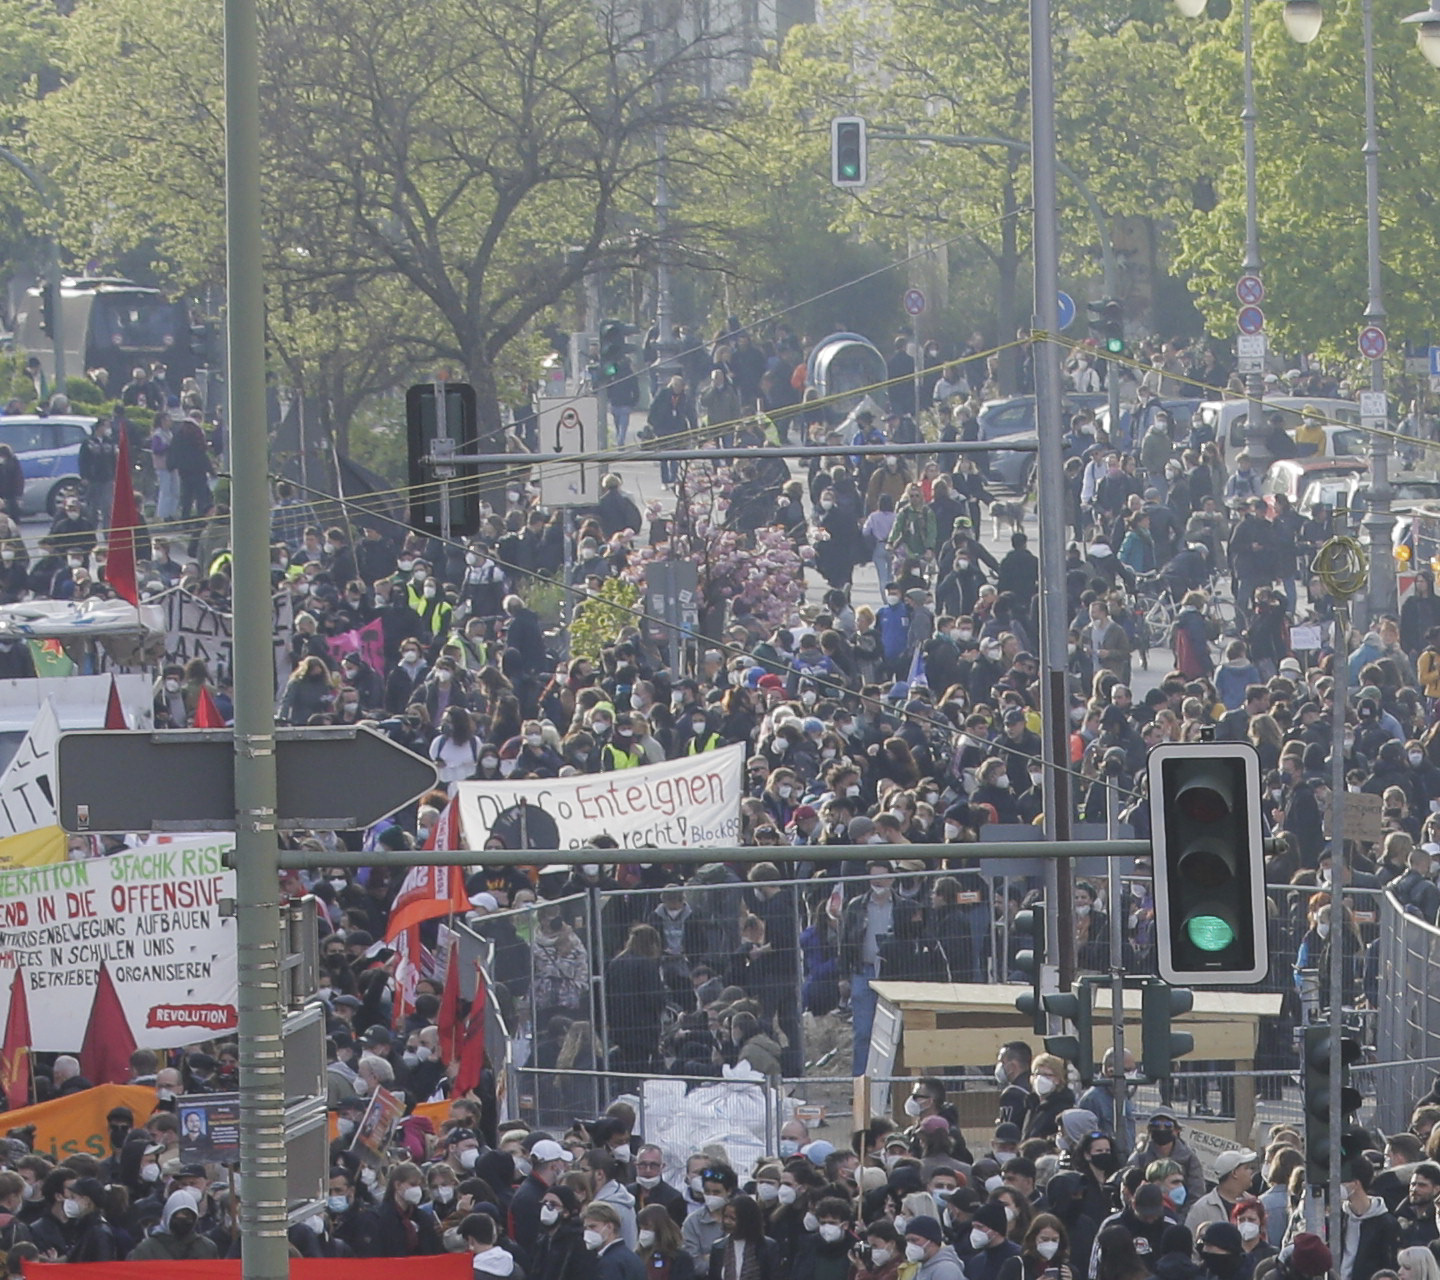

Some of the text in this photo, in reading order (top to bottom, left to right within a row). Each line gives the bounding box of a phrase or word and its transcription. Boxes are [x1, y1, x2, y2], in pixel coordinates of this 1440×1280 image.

[576, 771, 725, 820] Enteignen
[38, 896, 57, 924] IN
[67, 889, 97, 919] DIE
[111, 876, 224, 913] OFFENSIVE
[135, 910, 210, 936] AUFBAUEN
[69, 939, 135, 965] SCHULEN
[143, 938, 175, 958] UNIS
[116, 962, 212, 983] ORGANISIEREN
[156, 1008, 228, 1023] REVOLUTION
